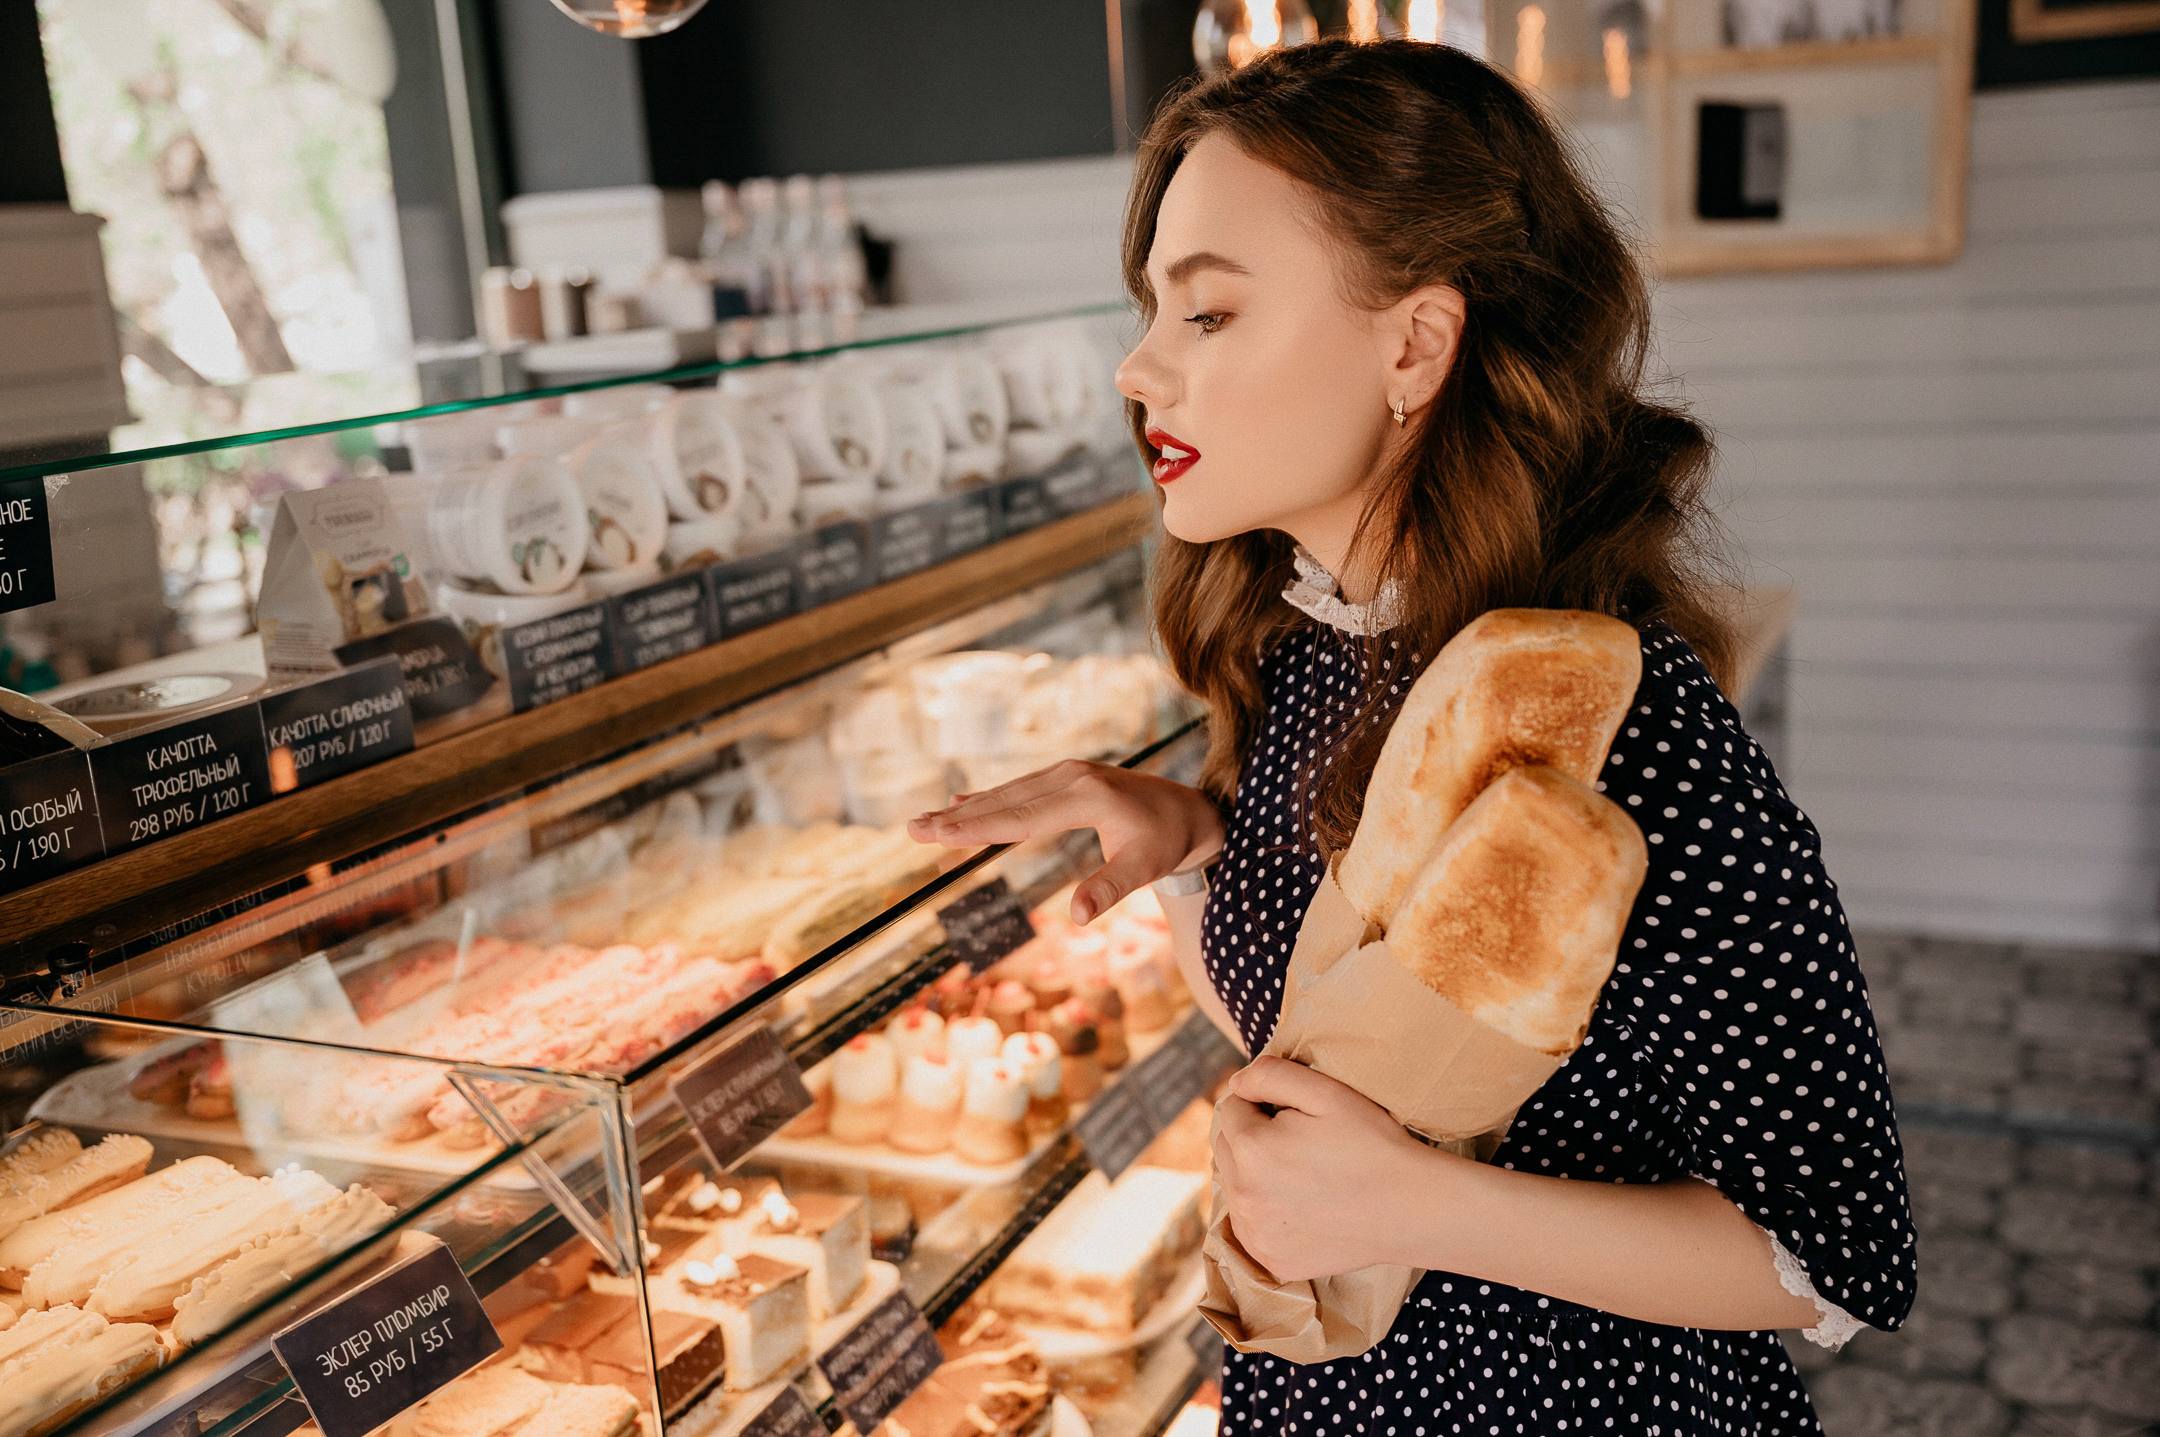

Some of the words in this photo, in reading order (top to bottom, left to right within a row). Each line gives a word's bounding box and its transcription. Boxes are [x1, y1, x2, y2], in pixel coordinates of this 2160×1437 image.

[0, 498, 34, 526] НОЕ
[17, 568, 27, 592] Г
[268, 713, 331, 749] КАЧОТТА
[330, 686, 405, 730] СЛИВОЧНЫЙ
[319, 735, 347, 761] РУБ
[349, 729, 357, 754] /
[359, 722, 383, 748] 120
[383, 718, 392, 740] Г
[146, 732, 218, 772] КАЧОТТА
[131, 752, 241, 808] ТРЮФЕЛЬНЫЙ
[10, 787, 84, 832] ОСОБЫЙ
[129, 813, 161, 842] 298
[163, 801, 195, 831] РУБ
[199, 794, 208, 821] /
[212, 786, 240, 813] 120
[241, 782, 252, 804] Г
[13, 840, 21, 870] /
[28, 831, 61, 861] 190
[64, 826, 74, 849] Г
[315, 1329, 373, 1377] ЭКЛЕР
[373, 1284, 451, 1344] ПЛОМБИР
[344, 1370, 371, 1398] 85
[369, 1349, 407, 1385] РУБ
[409, 1336, 417, 1365] /
[421, 1326, 445, 1353] 55
[441, 1317, 454, 1340] Г
